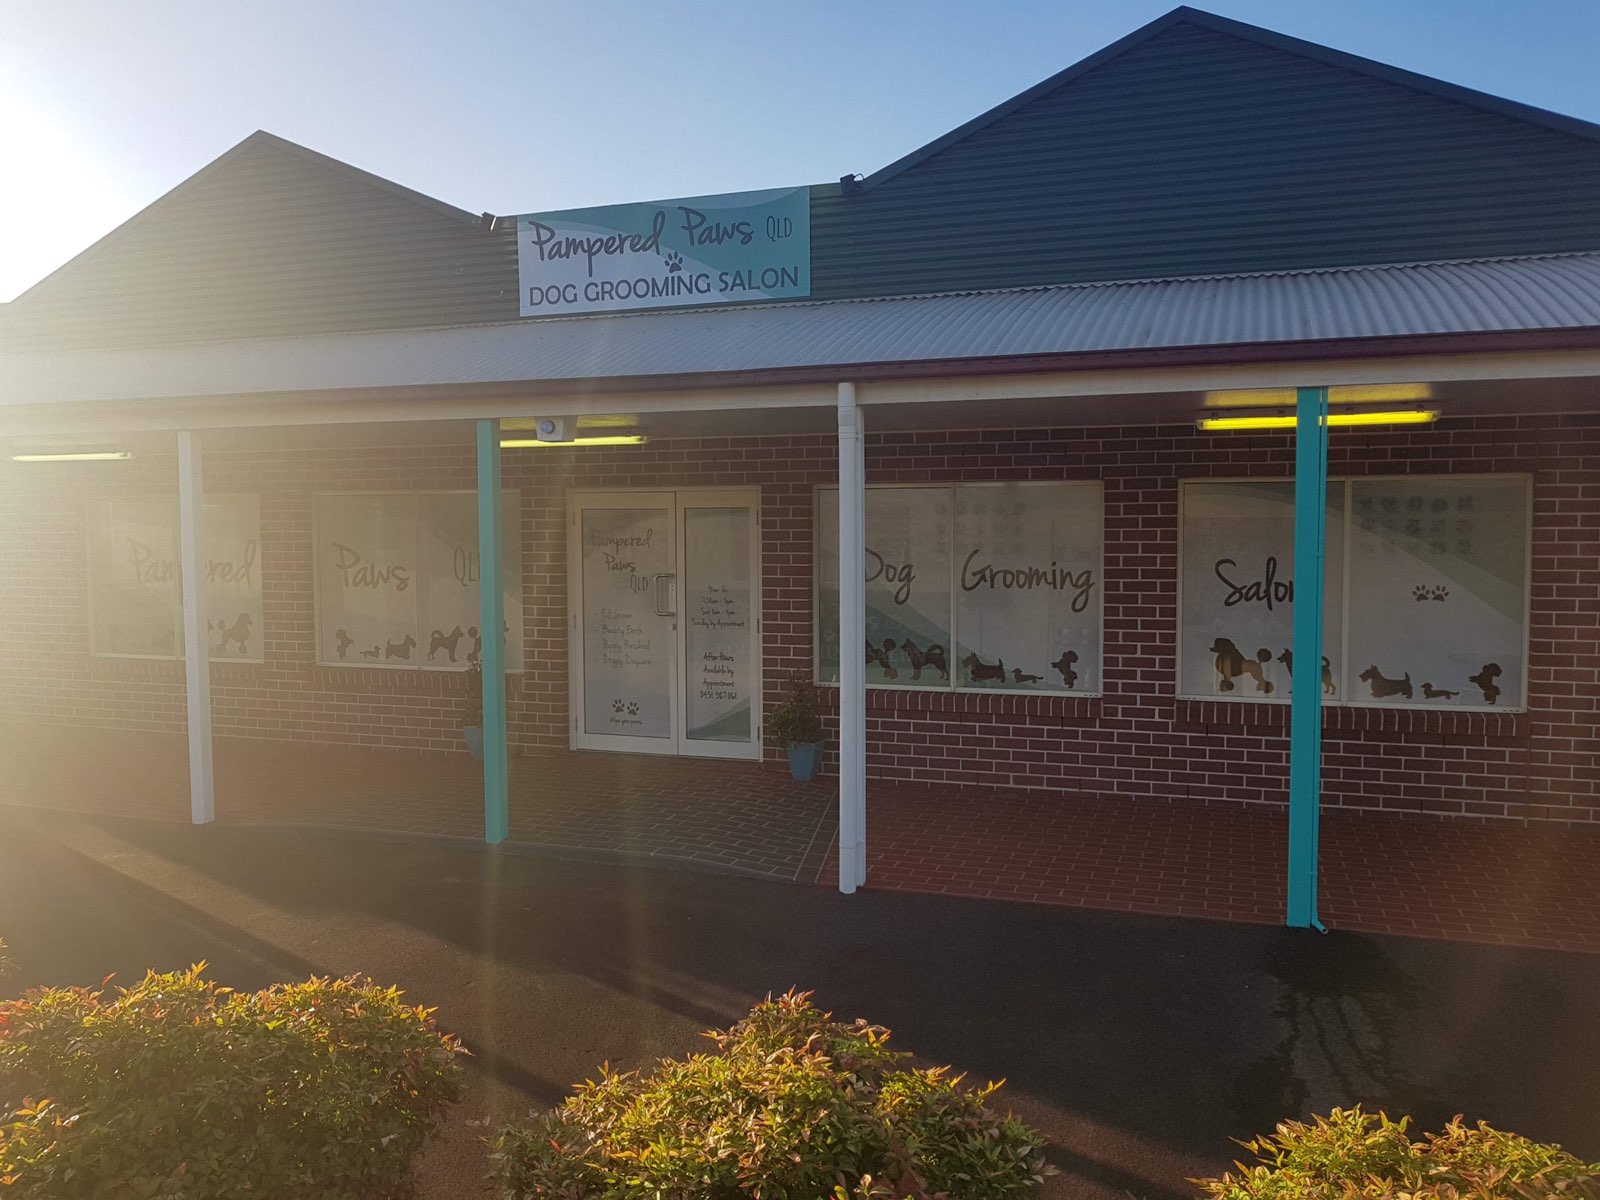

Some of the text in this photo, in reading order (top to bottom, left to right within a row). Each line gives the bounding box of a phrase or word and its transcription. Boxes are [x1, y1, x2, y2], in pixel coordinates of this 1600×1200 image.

[528, 205, 793, 277] Pampered Paws QLD
[529, 266, 799, 307] DOG GROOMING SALON
[331, 541, 410, 592] Paws
[454, 546, 480, 587] QL
[604, 552, 637, 573] Paws
[630, 574, 649, 594] QLD
[960, 548, 1096, 613] Grooming
